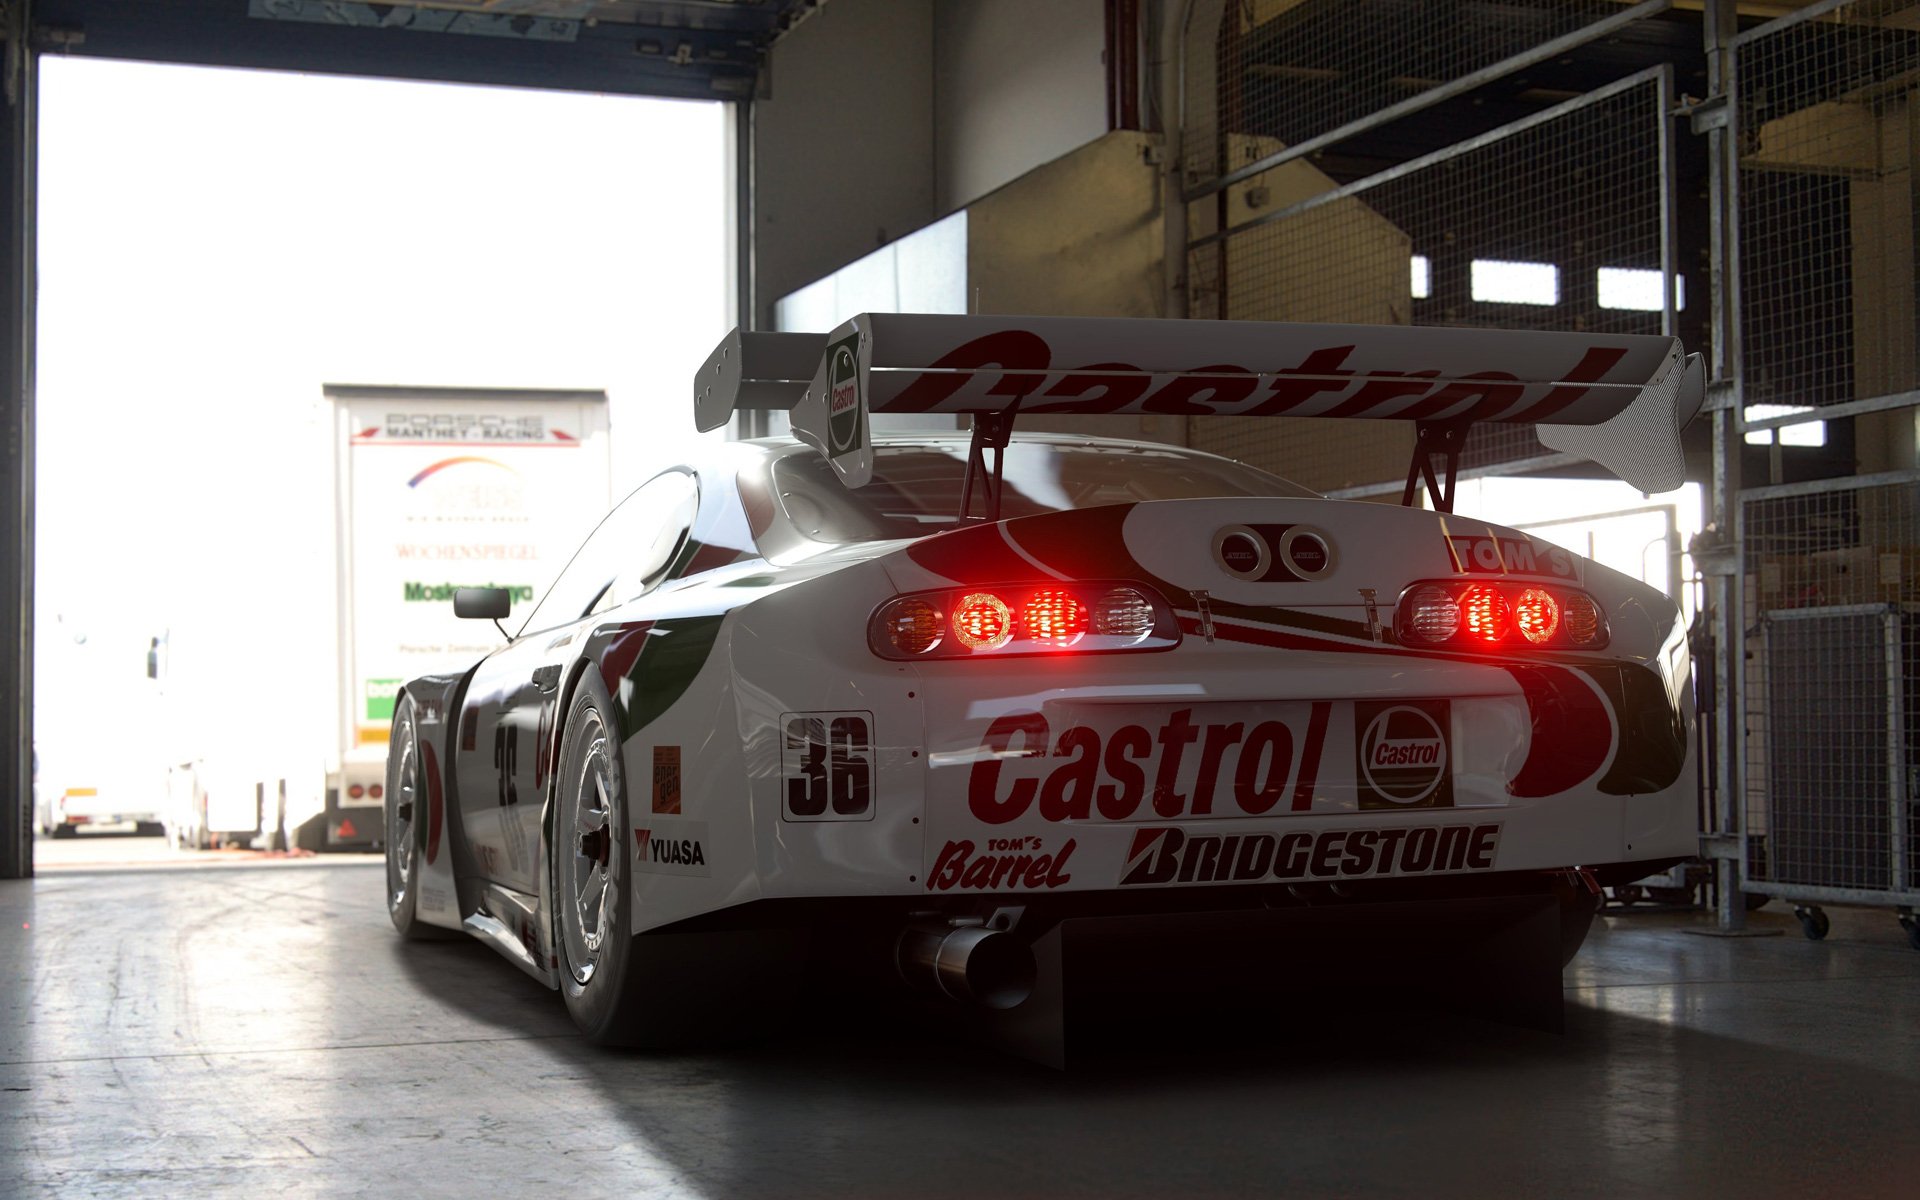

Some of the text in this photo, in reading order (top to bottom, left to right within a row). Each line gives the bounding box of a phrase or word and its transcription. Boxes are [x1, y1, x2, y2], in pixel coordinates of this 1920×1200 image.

[832, 385, 855, 412] Castrol
[385, 413, 543, 427] PORSCHE
[385, 427, 468, 439] MANTHEY
[482, 429, 544, 440] RACING
[786, 716, 871, 816] 36
[968, 701, 1333, 825] Castrol
[1373, 741, 1442, 767] Castrol
[650, 838, 706, 865] YUASA
[988, 836, 1042, 851] TOM'S
[1120, 823, 1500, 886] BRIDGESTONE
[926, 838, 1077, 891] Barrel
